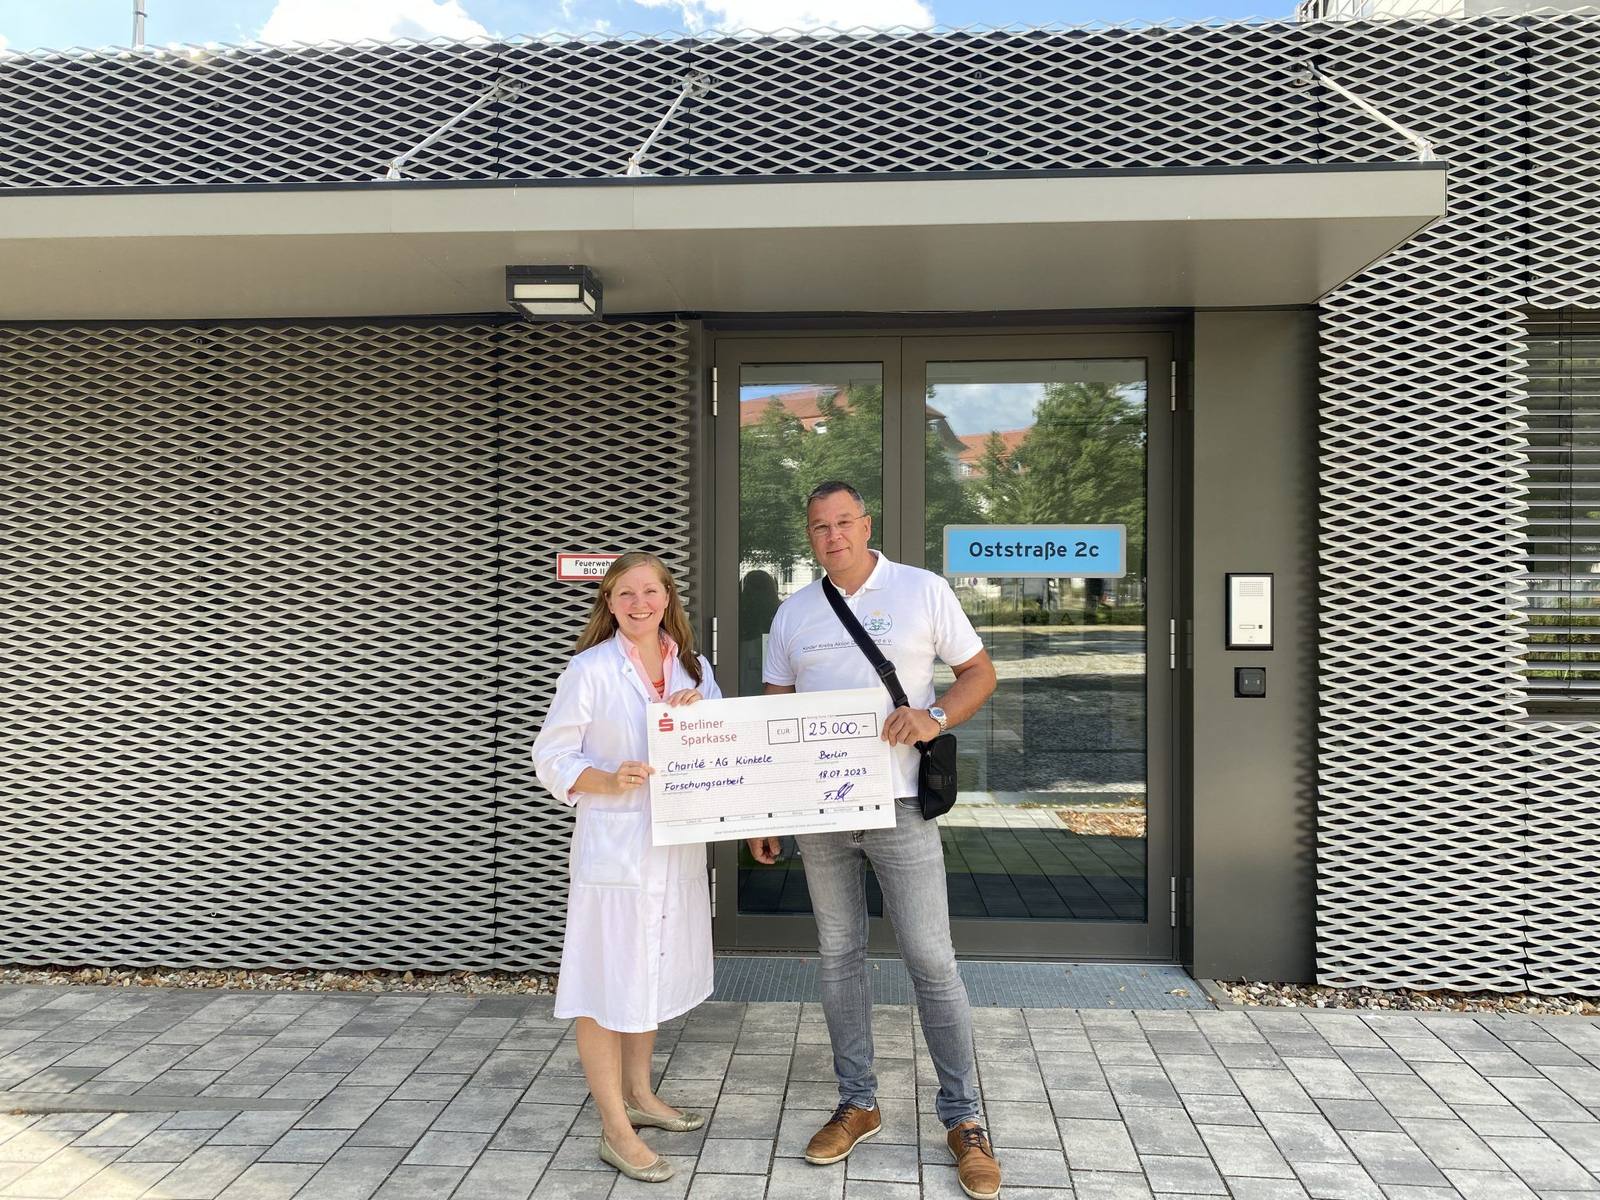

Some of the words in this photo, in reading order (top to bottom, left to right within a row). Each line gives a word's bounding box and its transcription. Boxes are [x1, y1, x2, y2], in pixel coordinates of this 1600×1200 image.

[969, 541, 1067, 560] Oststraße
[1074, 541, 1099, 557] 2c
[680, 719, 724, 731] Berliner
[681, 733, 737, 747] Sparkasse
[818, 750, 848, 760] Berlin
[664, 775, 745, 792] Forschungsarbeit
